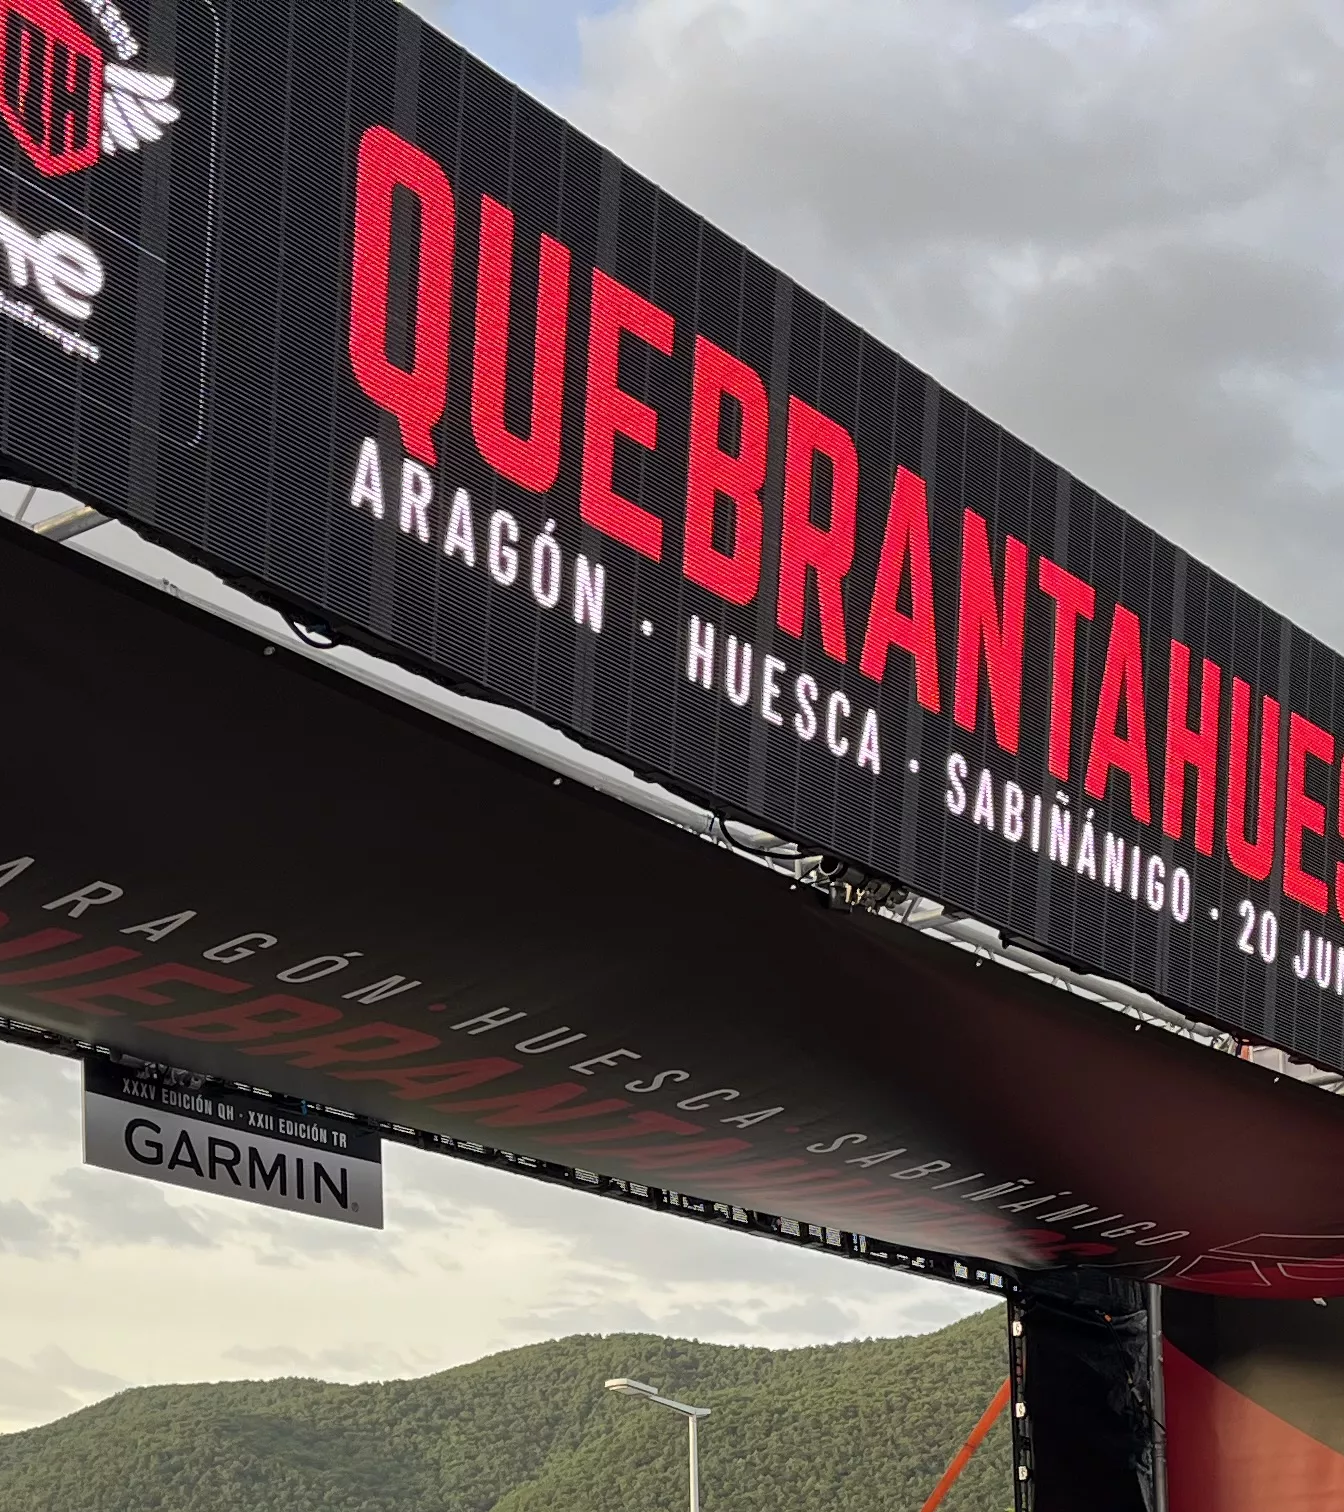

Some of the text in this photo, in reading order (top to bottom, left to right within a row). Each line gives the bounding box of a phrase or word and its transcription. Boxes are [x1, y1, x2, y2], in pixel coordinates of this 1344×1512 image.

[351, 437, 605, 635] ARAGÓN
[687, 614, 881, 775] HUESCA
[946, 752, 1191, 924] SABIÑÁNIGO
[1239, 901, 1277, 964] 20
[122, 1077, 347, 1149] XXXV EDICIÓN QH XXII EDICIÓN TR
[124, 1117, 349, 1210] GARMIN
[450, 1004, 786, 1131] HUESCA
[807, 1129, 1191, 1249] SABIÑÁNIGO
